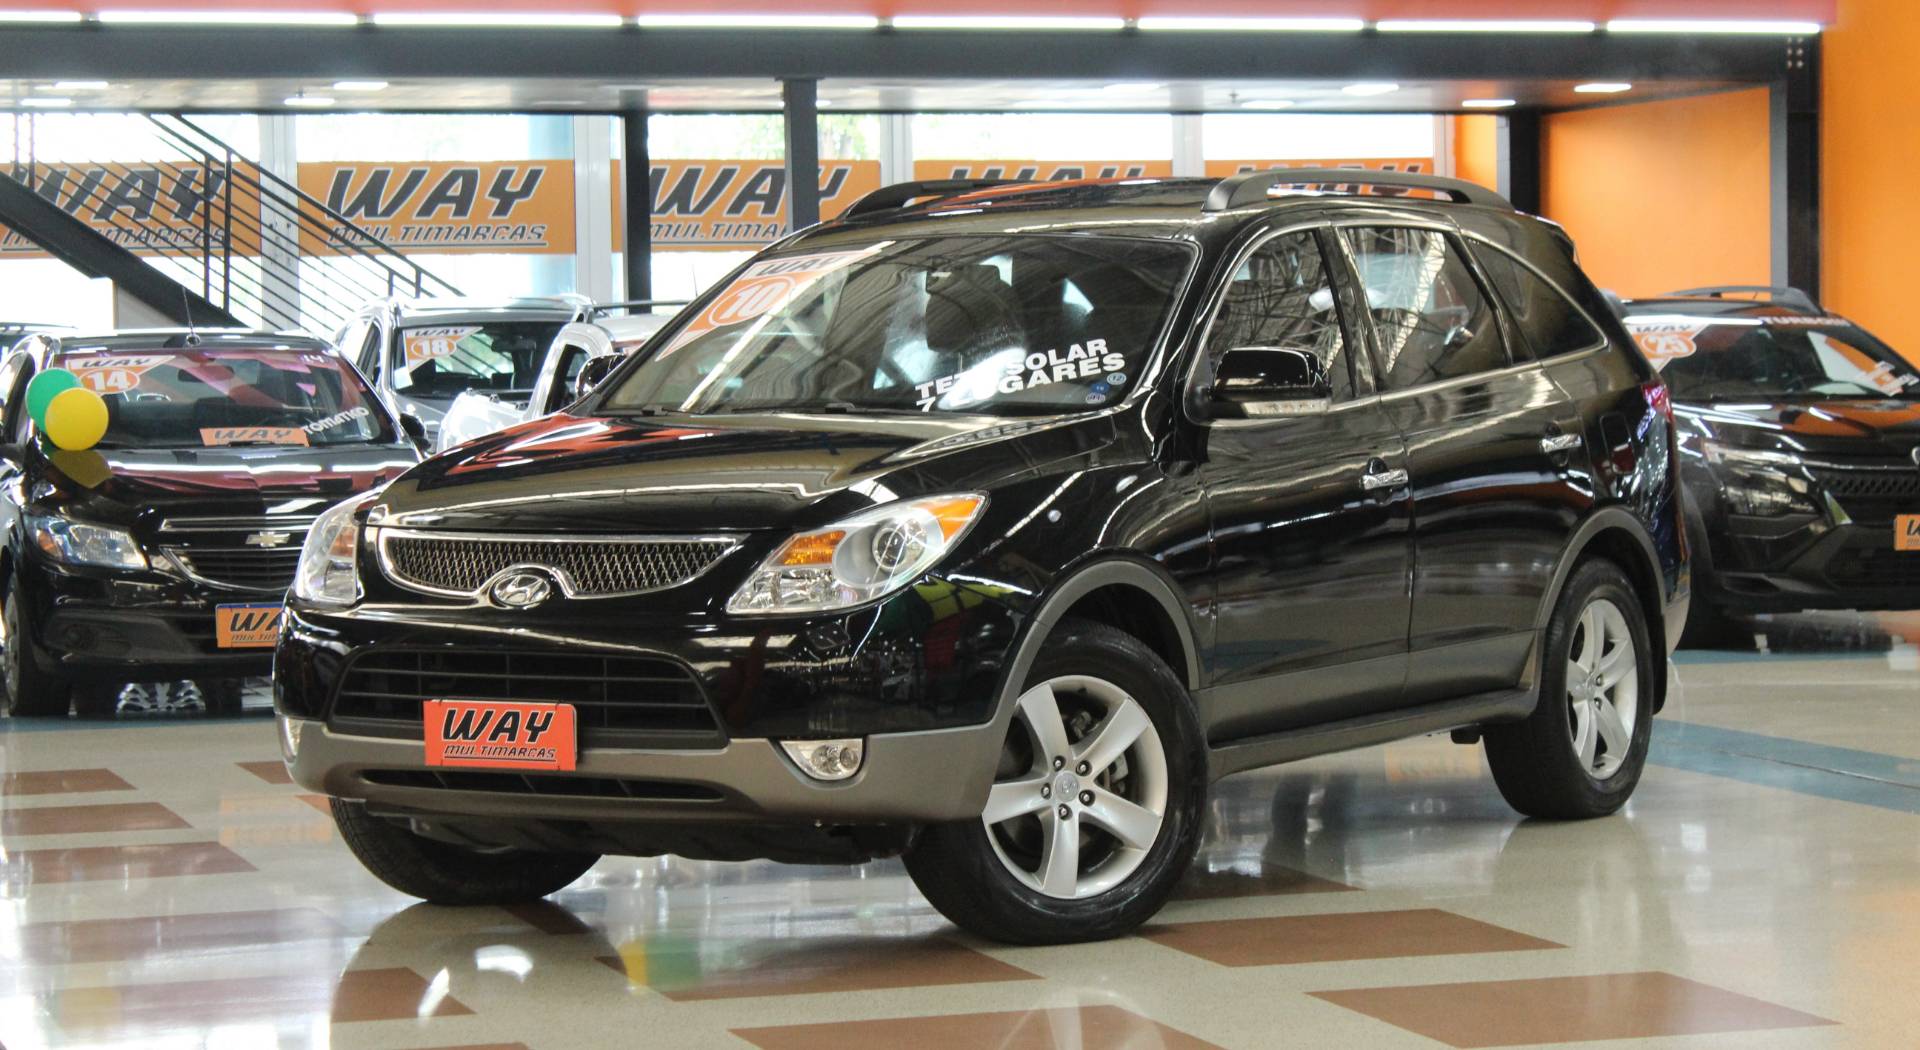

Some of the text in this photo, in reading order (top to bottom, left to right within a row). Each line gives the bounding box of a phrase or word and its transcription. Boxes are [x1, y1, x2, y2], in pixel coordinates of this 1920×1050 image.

[326, 166, 547, 219] WAY
[719, 282, 786, 320] 10
[419, 339, 450, 356] 18
[1006, 338, 1109, 375] SOLAR
[82, 358, 151, 367] WAY
[998, 352, 1125, 394] GARES
[90, 370, 130, 391] 14
[214, 429, 292, 440] WAY
[442, 708, 556, 744] WAY
[444, 745, 556, 759] MULTIMARCAS
